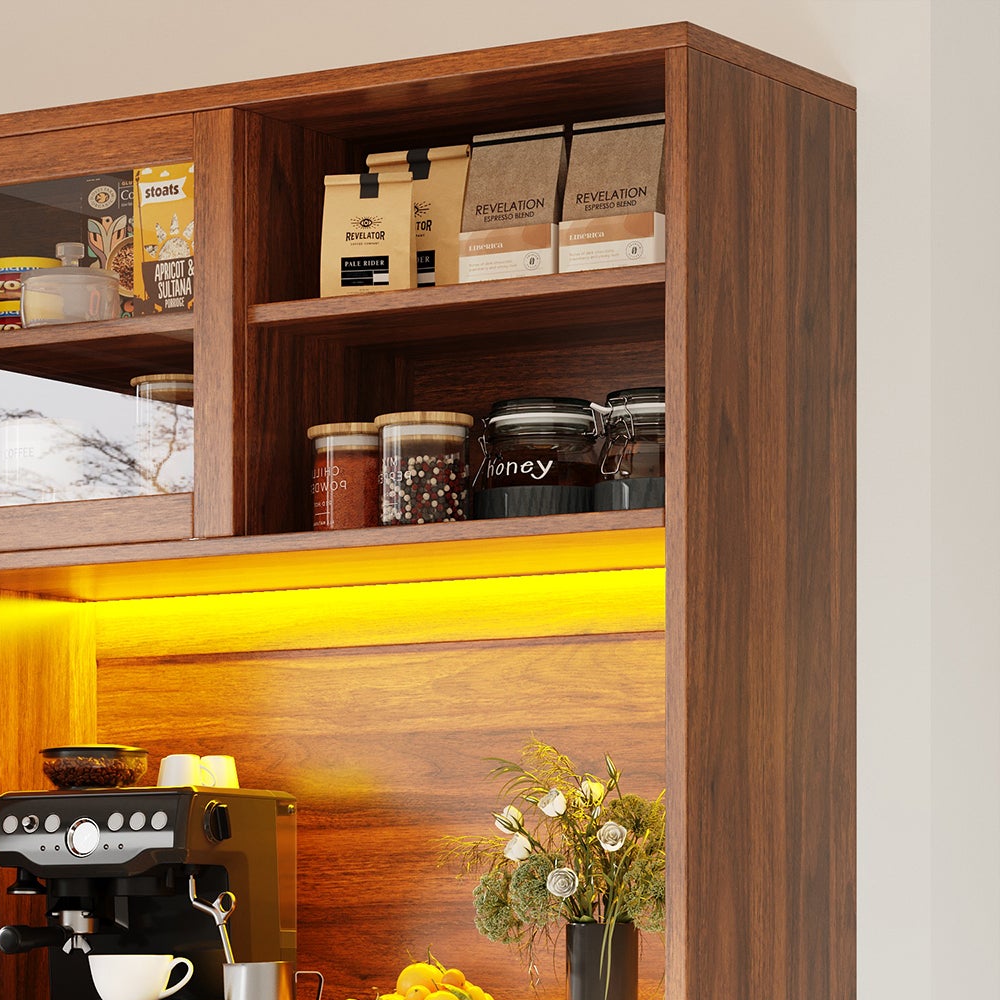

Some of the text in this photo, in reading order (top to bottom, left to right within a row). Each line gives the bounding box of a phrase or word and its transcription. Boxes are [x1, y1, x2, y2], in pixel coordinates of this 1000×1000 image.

[145, 184, 179, 198] stoats
[575, 186, 648, 204] REVELATION
[475, 198, 545, 215] REVELATION
[584, 202, 615, 211] ESPRESSO
[483, 211, 535, 222] ESPRESSO BLEND
[415, 219, 433, 231] TOR
[345, 231, 386, 241] REVELATOR
[154, 260, 185, 282] APRICOT
[158, 277, 192, 299] SULTANA
[486, 459, 553, 479] honey
